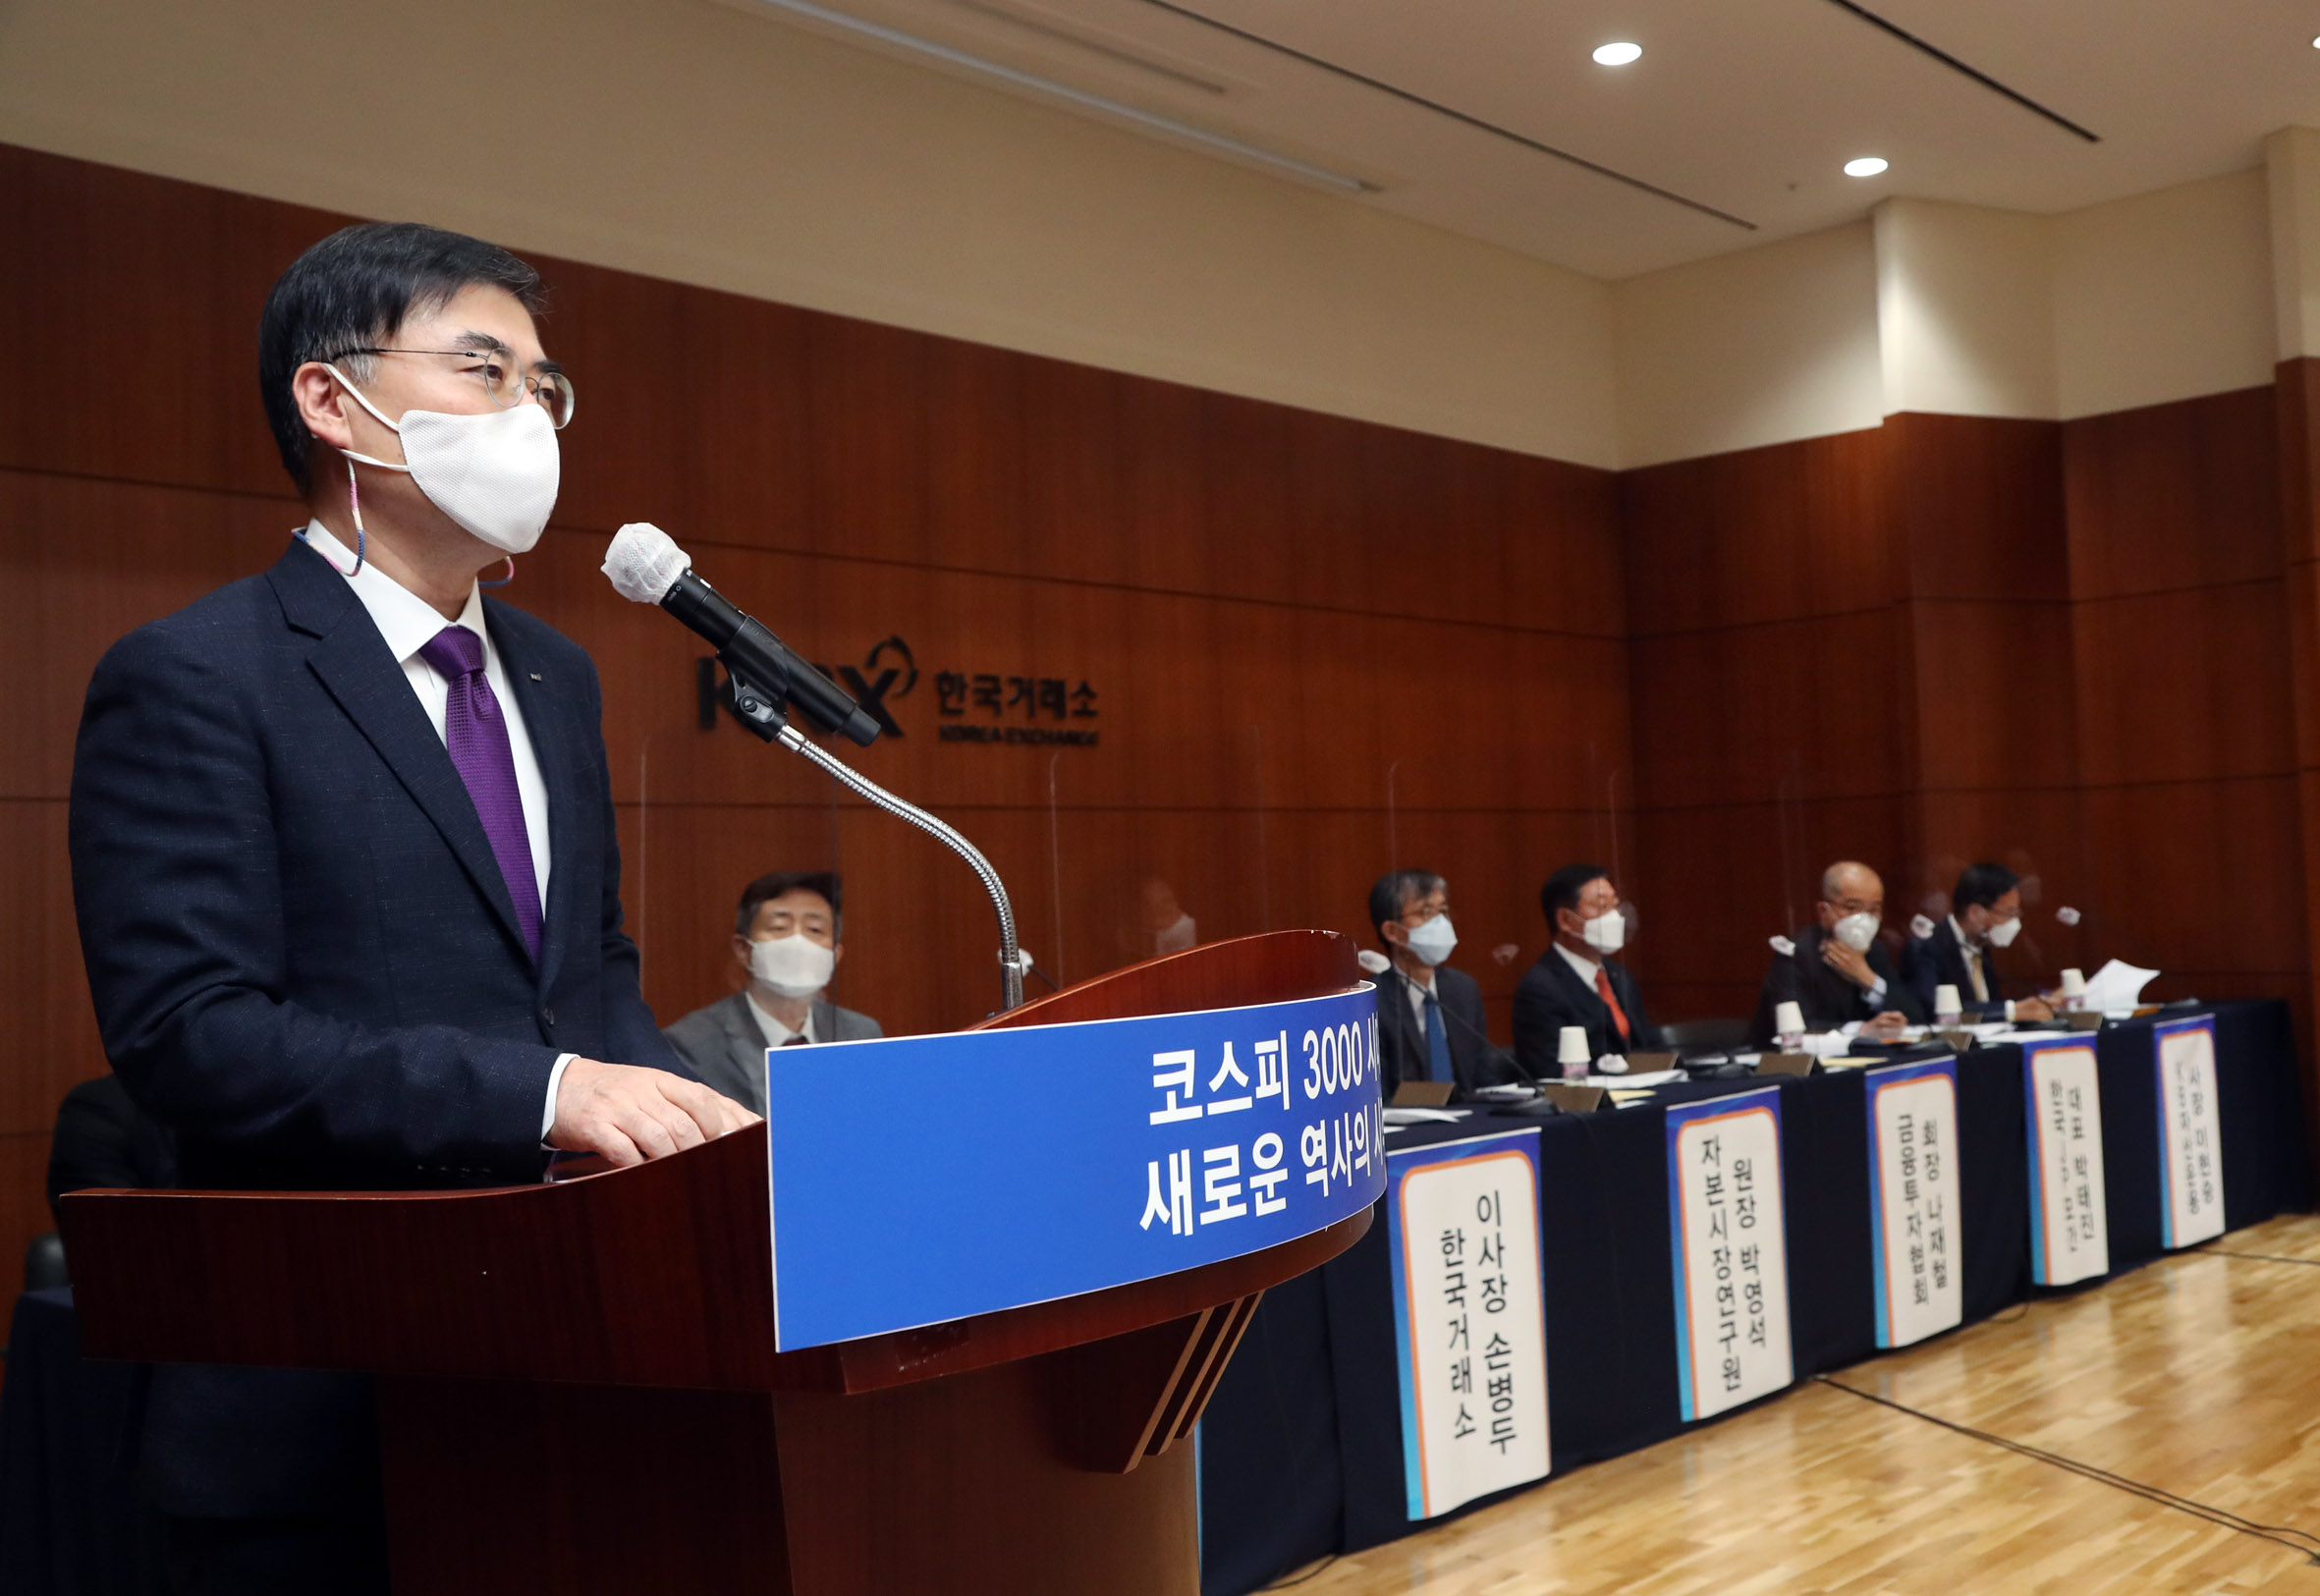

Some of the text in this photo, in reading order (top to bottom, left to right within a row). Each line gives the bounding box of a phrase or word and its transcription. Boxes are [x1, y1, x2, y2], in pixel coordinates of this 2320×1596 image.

[935, 669, 1099, 719] 한국거래소
[939, 725, 1098, 746] KOREA EXCHANGE
[1149, 1012, 1382, 1126] 코스피 3000 시
[1139, 1132, 1289, 1237] 새로운
[1300, 1104, 1371, 1197] 역사의
[1897, 1113, 1929, 1305] 금융투자협회
[1921, 1119, 1941, 1183] 회장
[1476, 1189, 1518, 1456] 이사장 손병두
[1700, 1134, 1741, 1393] 자본시장연구원
[1734, 1157, 1766, 1348] 원장 박영석
[1440, 1228, 1476, 1441] 한국거래소
